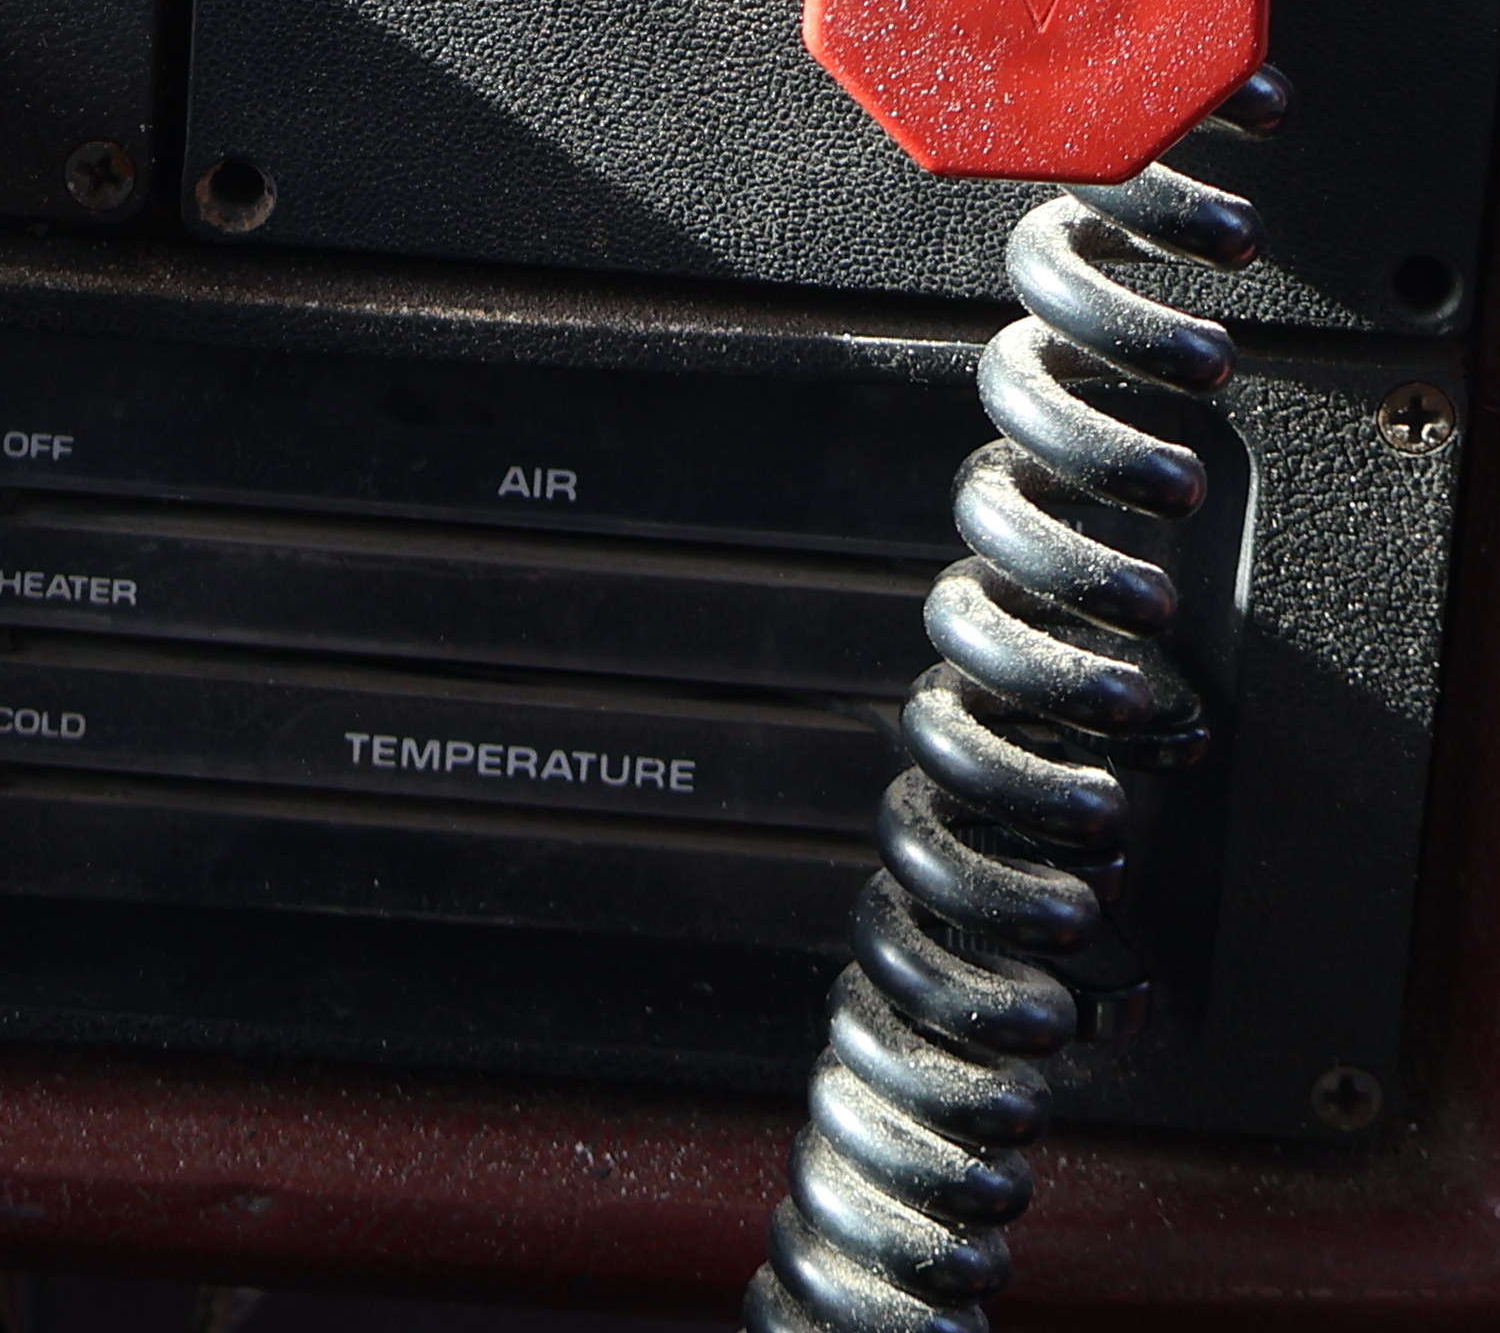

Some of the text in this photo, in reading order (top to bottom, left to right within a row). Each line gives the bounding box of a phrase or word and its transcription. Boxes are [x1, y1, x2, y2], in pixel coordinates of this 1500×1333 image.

[2, 430, 75, 462] OFF
[498, 465, 579, 502] AIR
[344, 731, 698, 794] TEMPERATURE
